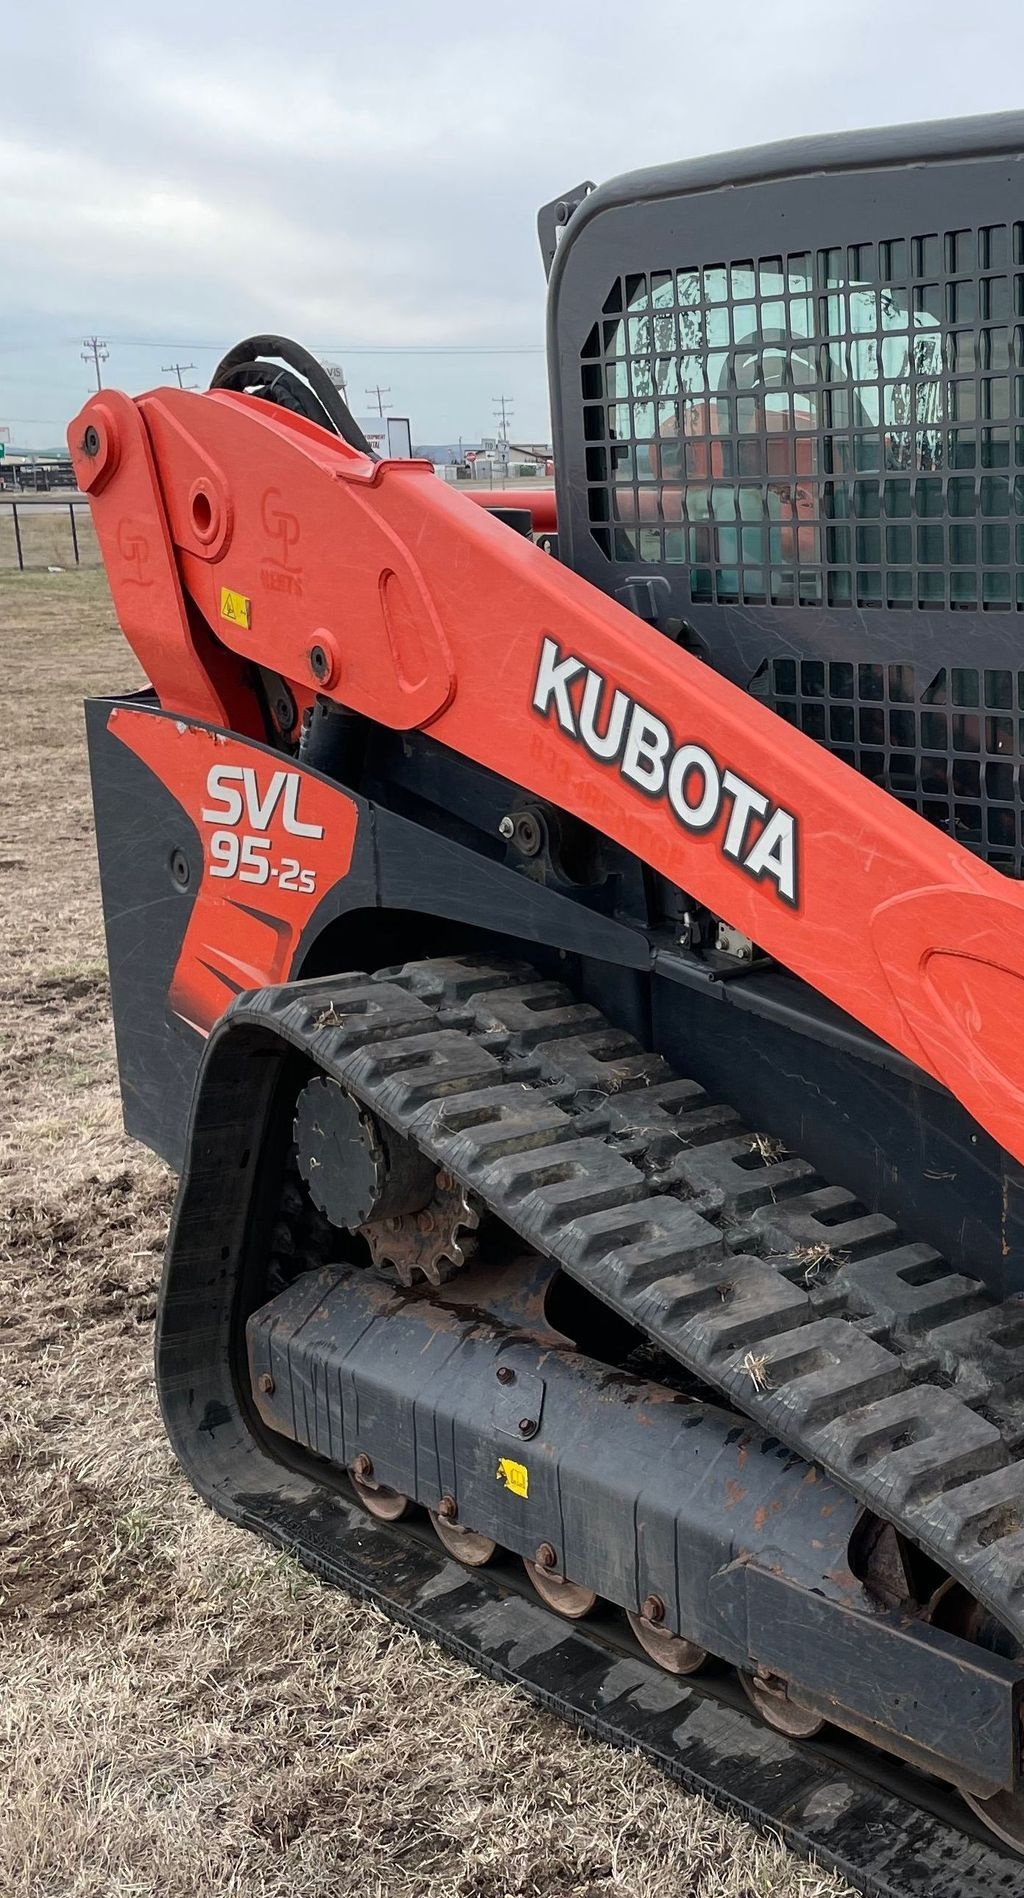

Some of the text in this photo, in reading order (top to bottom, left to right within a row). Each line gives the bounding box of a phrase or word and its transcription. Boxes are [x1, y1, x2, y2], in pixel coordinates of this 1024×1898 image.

[327, 367, 341, 377] VIS
[202, 764, 324, 840] SVL
[532, 635, 797, 903] KUBOTA
